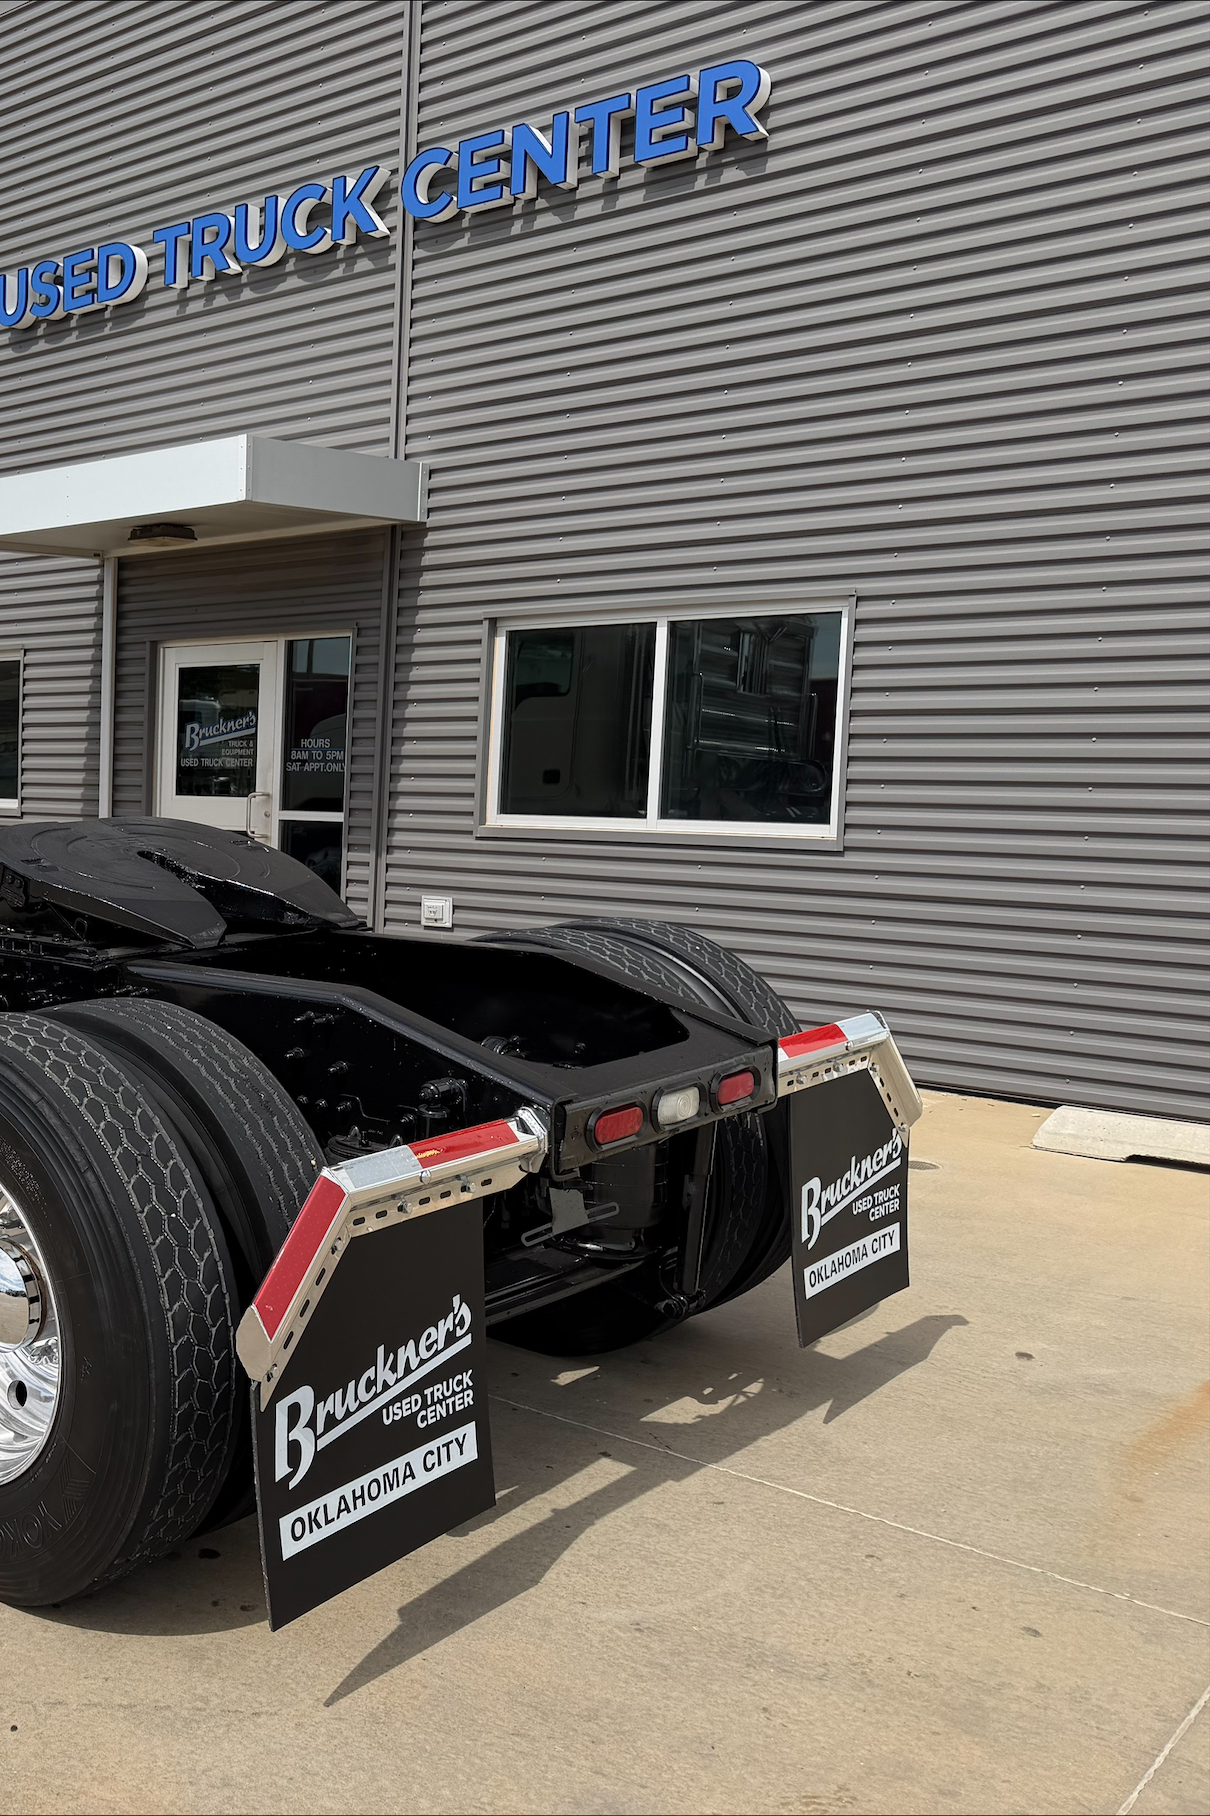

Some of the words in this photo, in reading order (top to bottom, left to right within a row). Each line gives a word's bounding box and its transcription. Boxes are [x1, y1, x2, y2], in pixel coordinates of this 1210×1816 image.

[153, 165, 388, 288] TRUCK
[401, 59, 769, 222] CENTER
[185, 711, 257, 751] Bruckner's
[228, 740, 248, 748] TRUCK
[249, 740, 254, 748] &
[300, 738, 331, 748] HOURS
[180, 758, 199, 767] USED
[200, 758, 225, 767] TRUCK
[225, 758, 253, 767] CENTER
[221, 748, 254, 756] EQUIPMENT
[291, 750, 309, 760] 8AM
[311, 750, 323, 760] TO
[325, 750, 344, 760] 5PM
[801, 1128, 902, 1250] Bruckner's
[852, 1198, 873, 1216] USED
[873, 1183, 900, 1204] TRUCK
[869, 1198, 900, 1222] CENTER
[809, 1246, 869, 1288] OKLAHOMA
[871, 1229, 896, 1259] CITY
[275, 1294, 472, 1490] Bruckner's
[382, 1393, 422, 1426] USED
[424, 1369, 474, 1402] TRUCK
[416, 1389, 475, 1429] CENTER
[290, 1461, 417, 1543] OKLAHOMA
[422, 1433, 468, 1473] CITY
